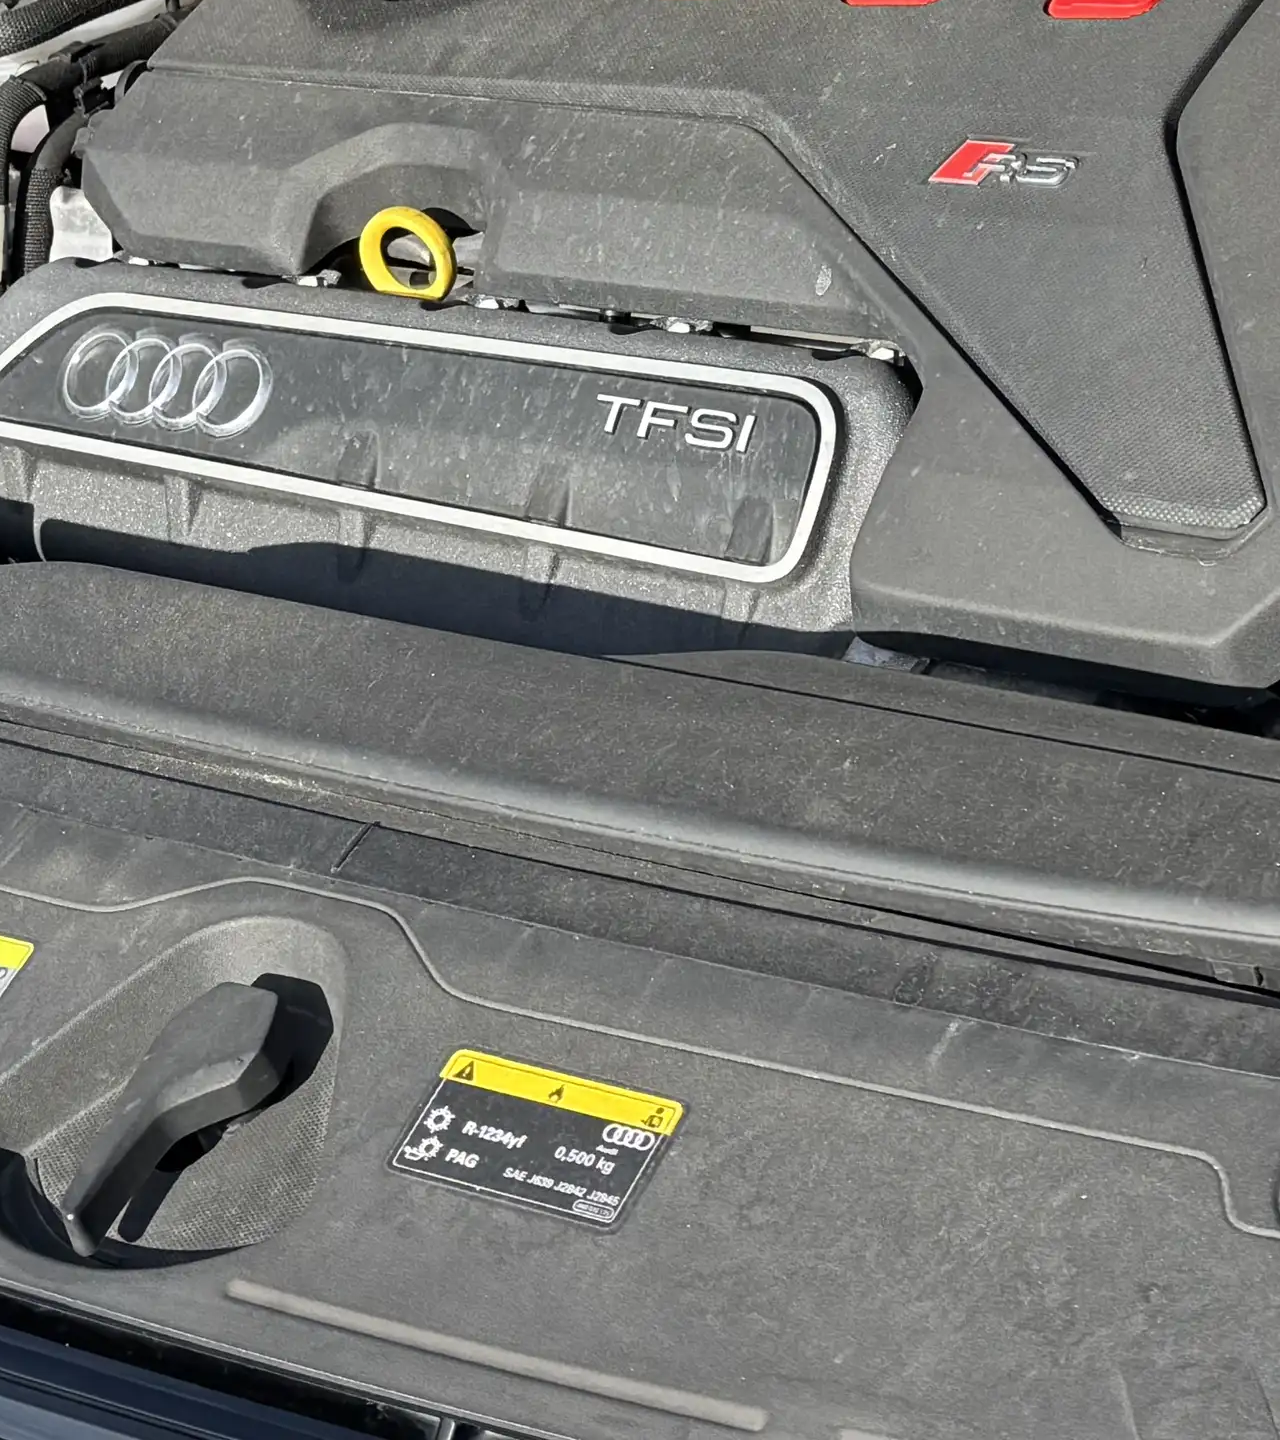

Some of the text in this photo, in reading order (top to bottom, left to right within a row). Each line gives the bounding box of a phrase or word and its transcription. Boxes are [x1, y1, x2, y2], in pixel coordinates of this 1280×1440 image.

[945, 148, 1078, 187] RS
[596, 393, 757, 454] TFSI
[462, 1121, 528, 1149] R-1234yf
[444, 1148, 480, 1169] PAG
[554, 1145, 616, 1176] 0,500 kg
[502, 1166, 528, 1182] SAE
